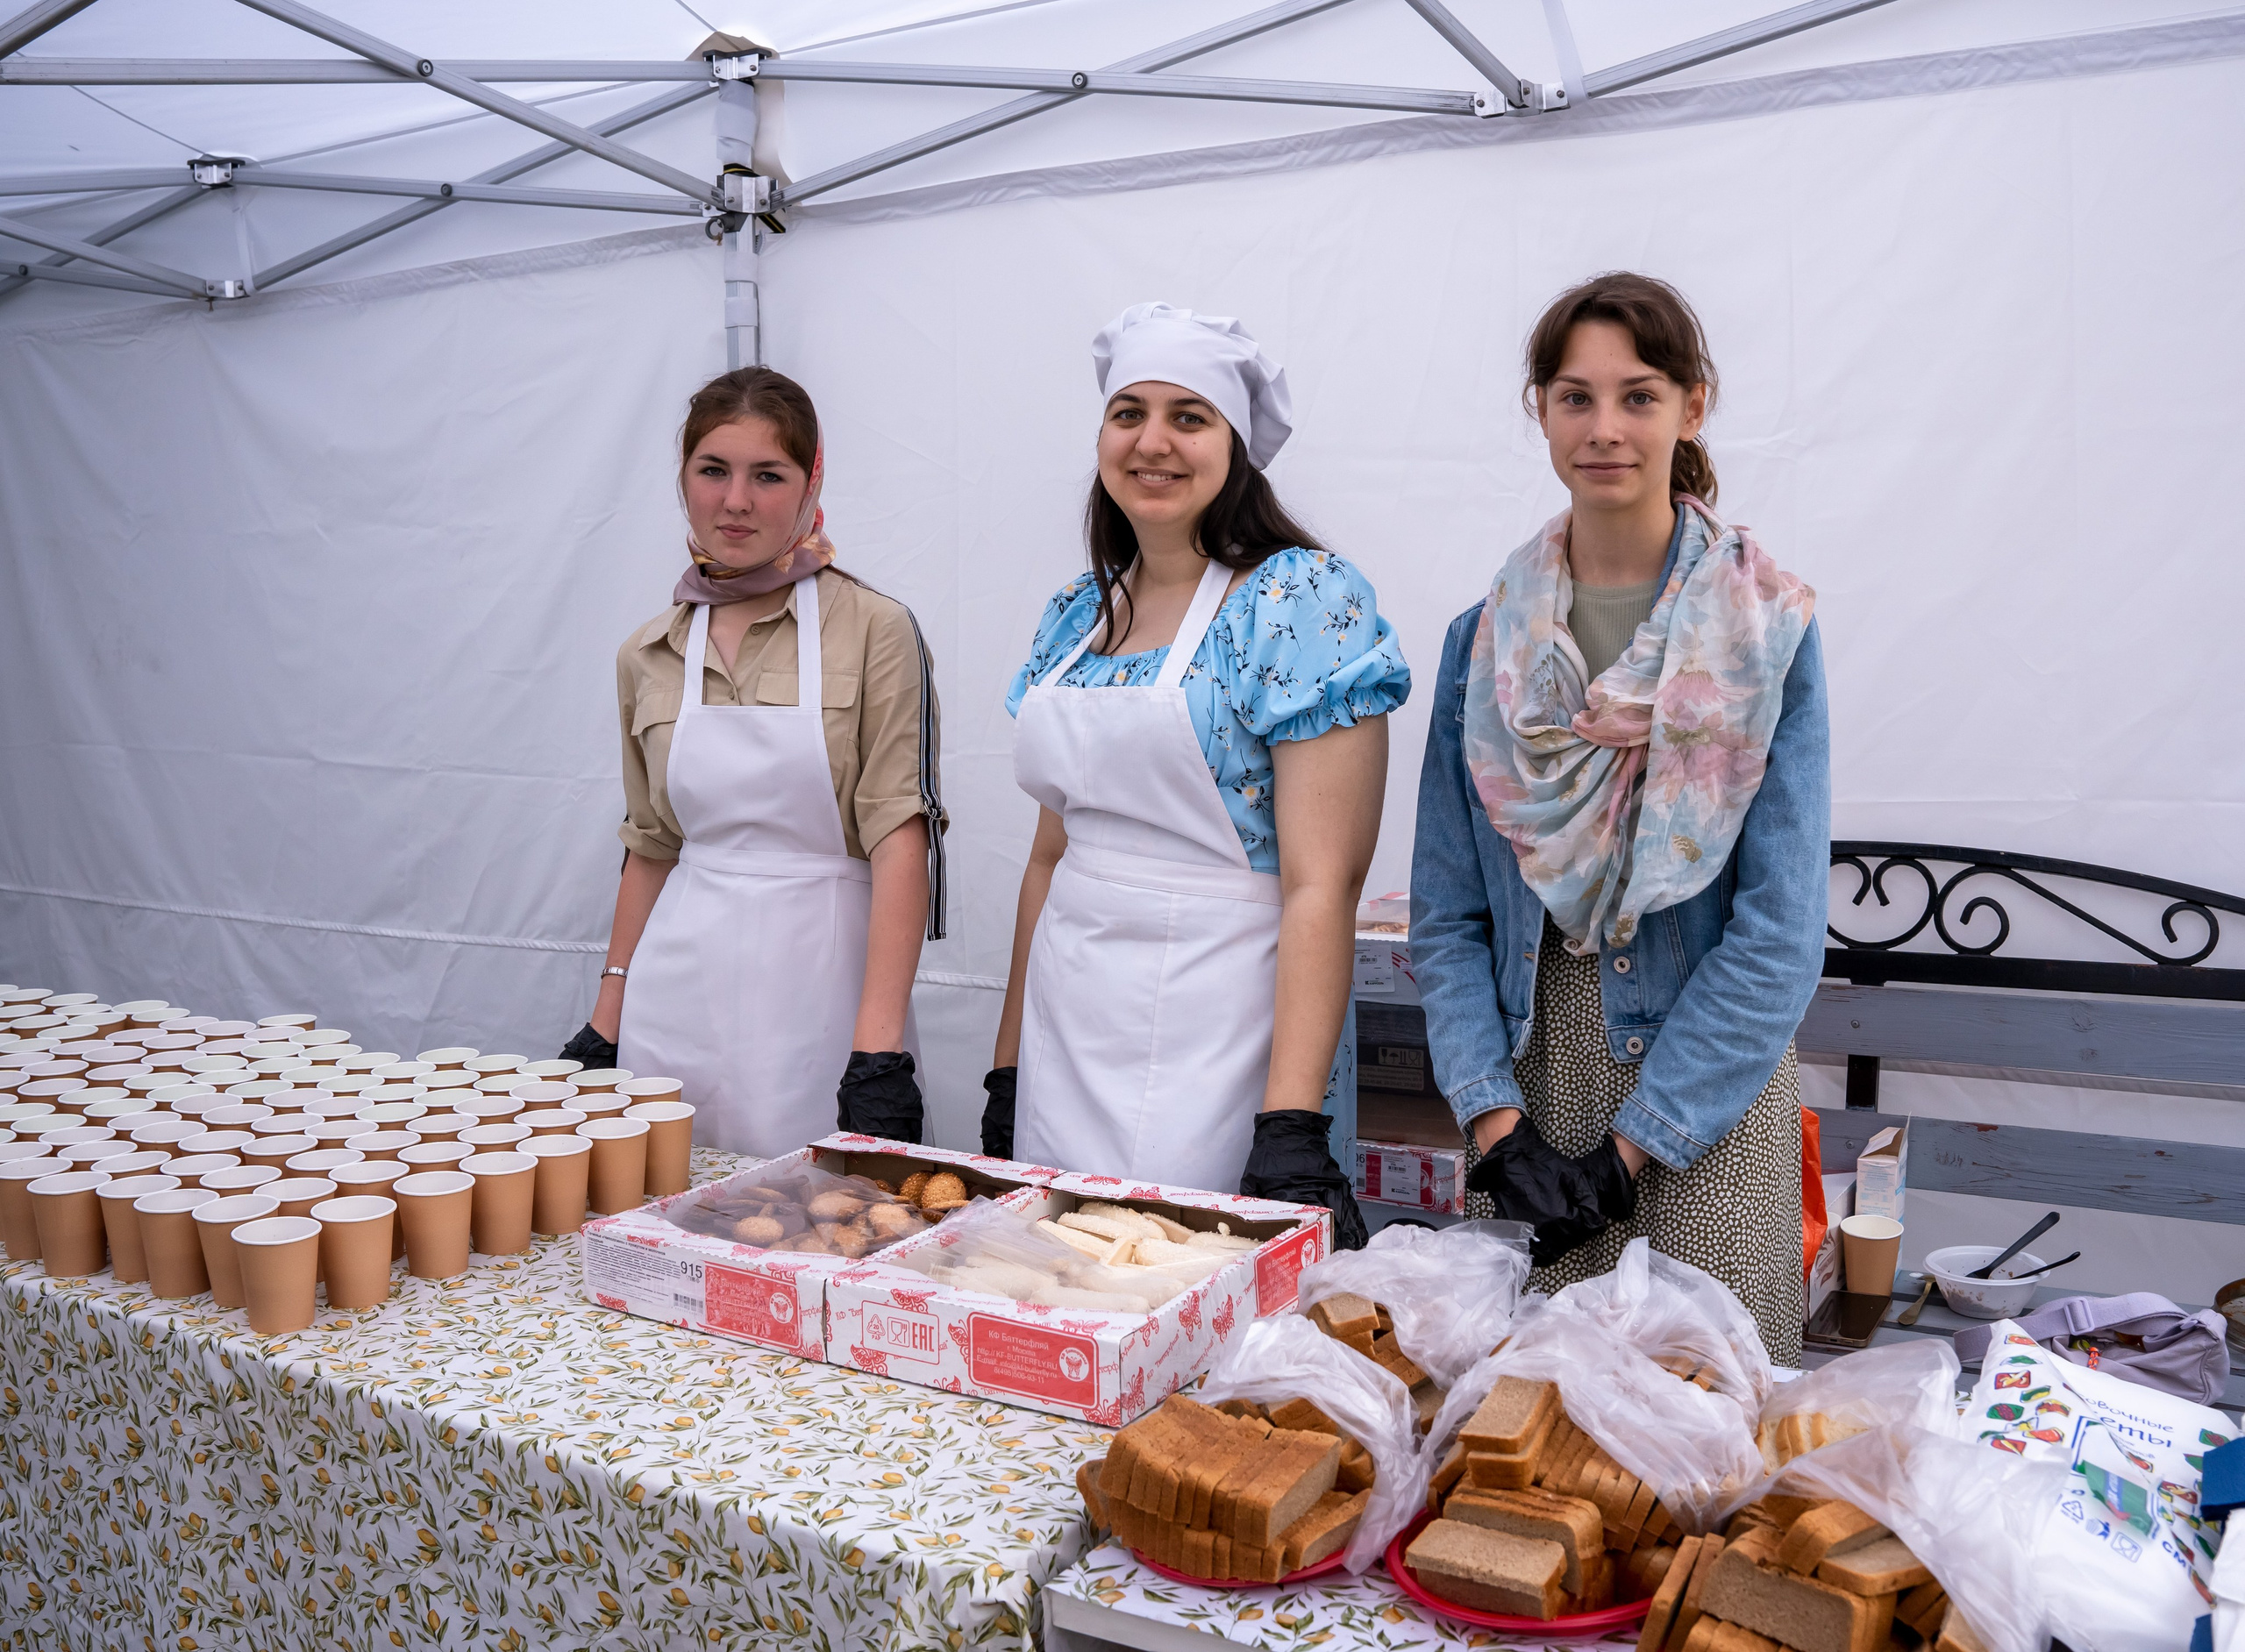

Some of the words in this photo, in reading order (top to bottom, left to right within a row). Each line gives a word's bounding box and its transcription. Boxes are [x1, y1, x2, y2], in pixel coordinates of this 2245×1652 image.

[681, 1261, 702, 1278] 915
[988, 1330, 1000, 1339] КФ
[1002, 1333, 1049, 1350] Баттерфляй
[1012, 1346, 1036, 1357] Москва
